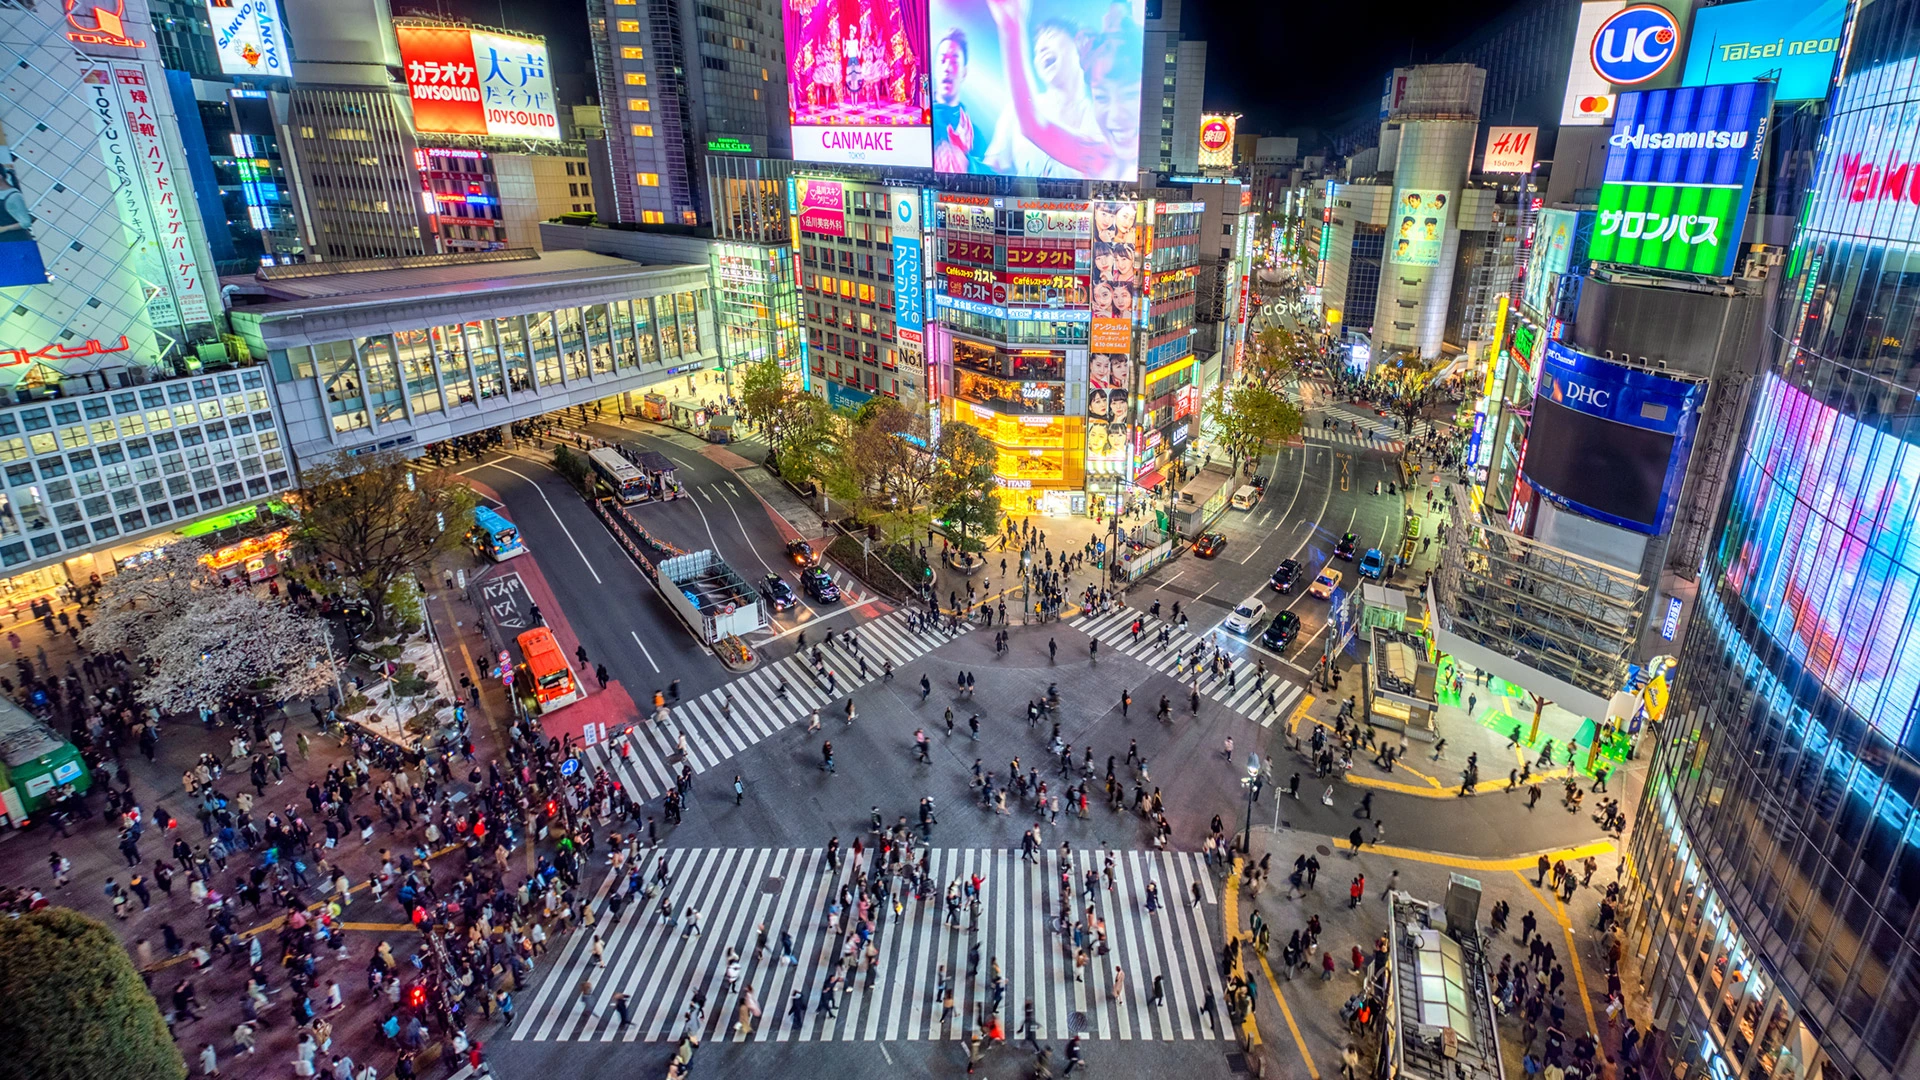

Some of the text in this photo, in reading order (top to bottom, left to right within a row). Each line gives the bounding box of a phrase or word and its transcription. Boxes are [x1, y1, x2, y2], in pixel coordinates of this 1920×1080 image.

[218, 2, 251, 50] SANKYO
[255, 0, 279, 69] SANKYO
[66, 32, 147, 48] TOKYU
[1602, 26, 1672, 64] UC
[1719, 38, 1784, 62] Taisei
[408, 60, 475, 85] カラオケ
[479, 47, 545, 88] 大声
[413, 84, 480, 102] JOYSOUND
[488, 108, 555, 128] JOYSOUND
[822, 131, 893, 150] CANMAKE
[1492, 133, 1531, 155] H&M
[1609, 124, 1748, 149] Hisamitsu
[1751, 117, 1768, 160] サロンパス
[848, 152, 866, 160] TOKYO
[1600, 210, 1719, 246] サロンパス
[948, 242, 993, 260] プライス
[1008, 250, 1073, 265] コンタクト
[963, 283, 990, 300] ガスト
[1052, 275, 1083, 289] ガスト
[1566, 381, 1610, 408] DHC
